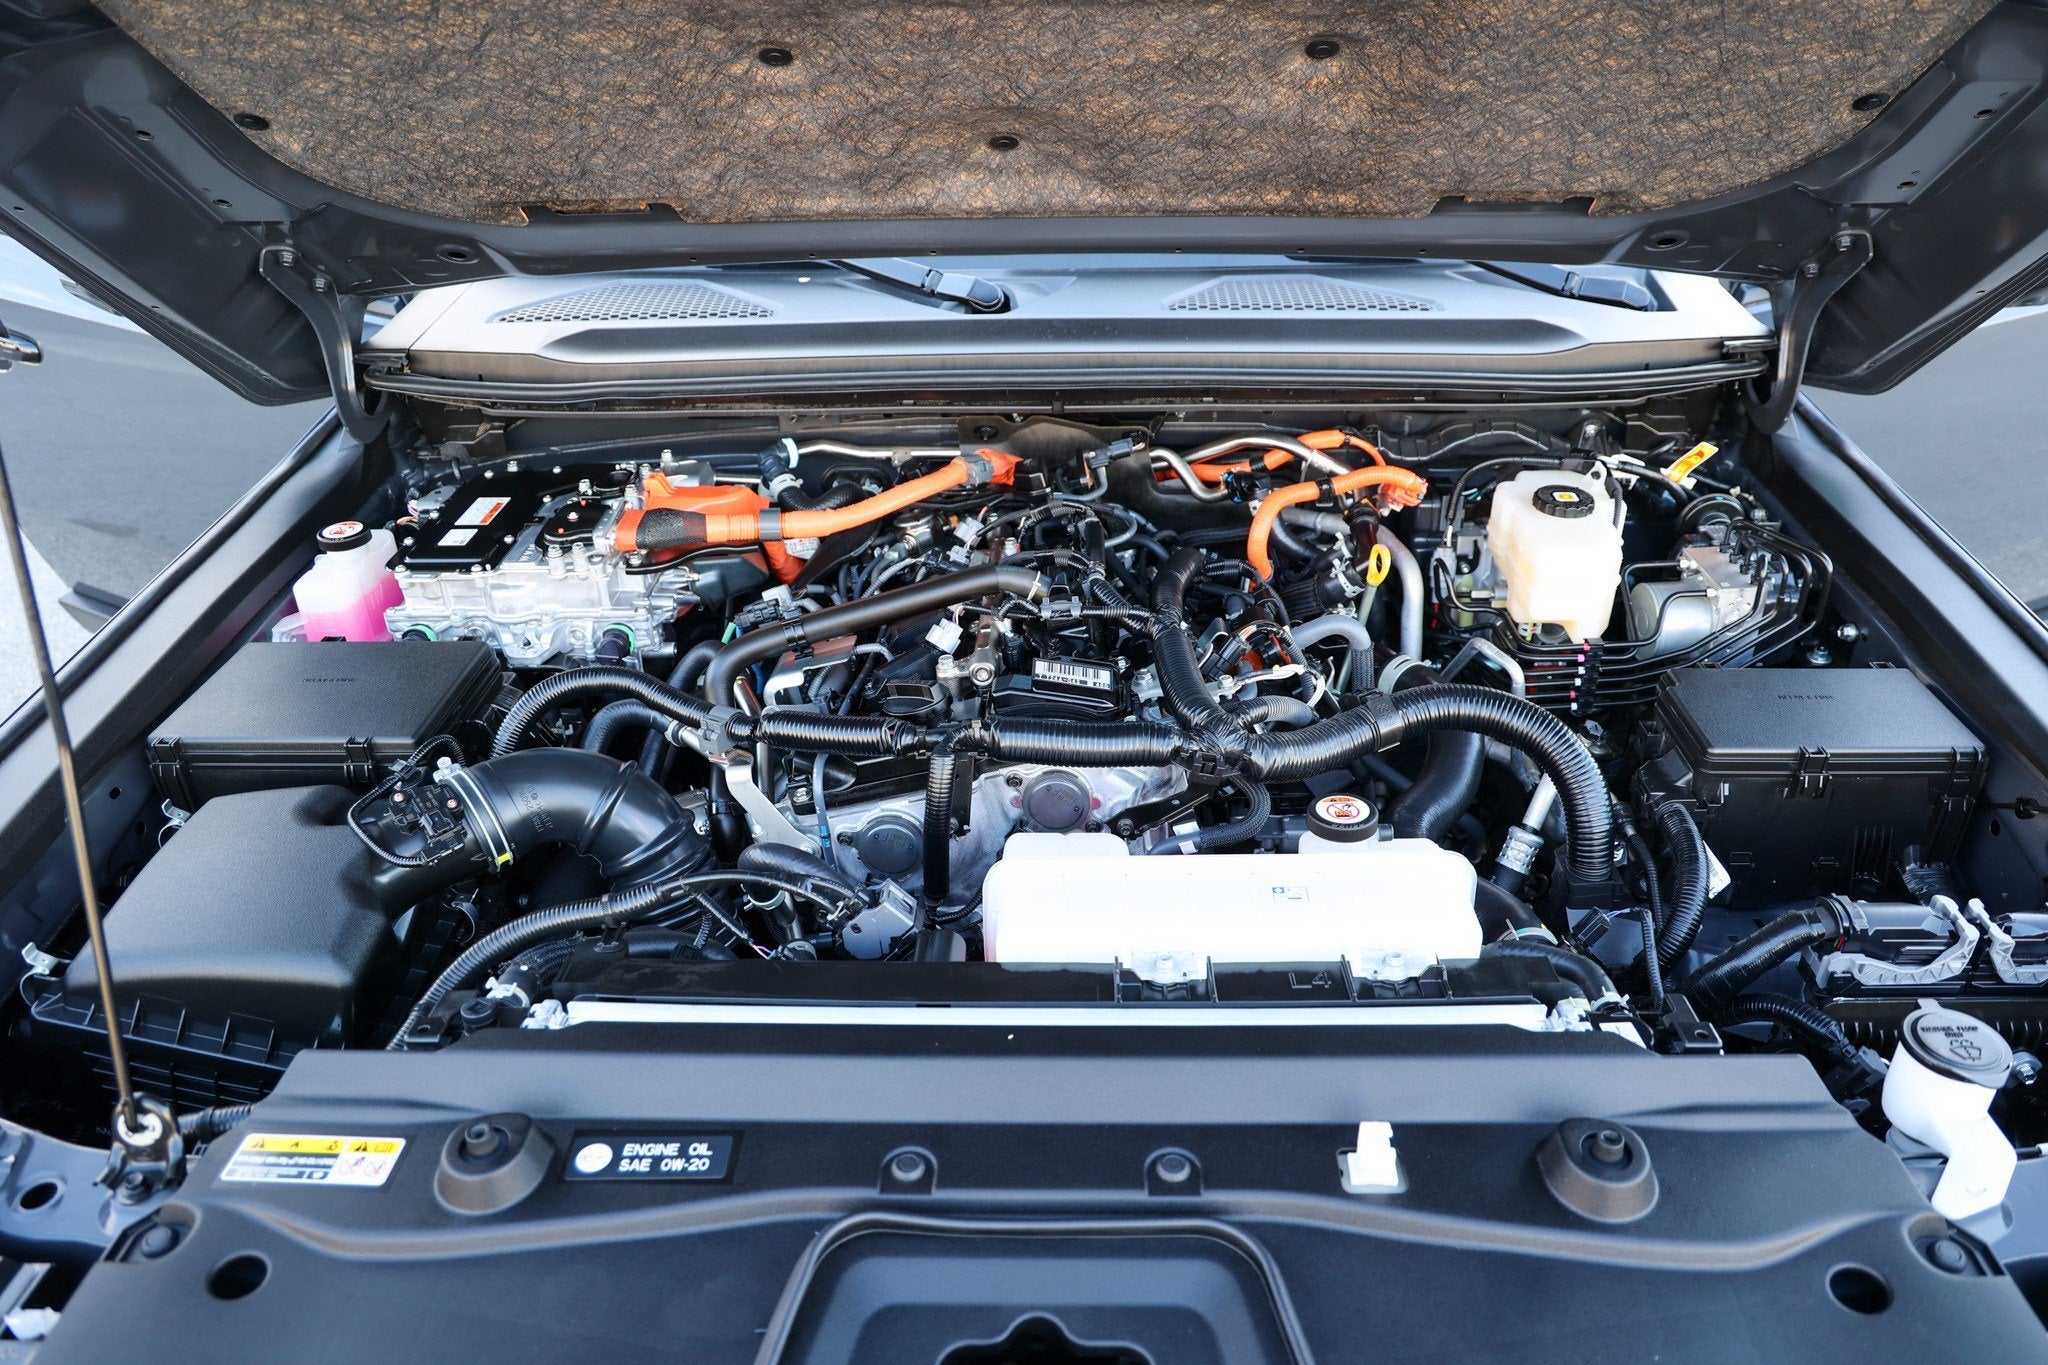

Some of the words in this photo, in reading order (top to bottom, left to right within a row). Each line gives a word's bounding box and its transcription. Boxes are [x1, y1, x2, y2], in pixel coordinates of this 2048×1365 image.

[1288, 970, 1332, 989] L4
[622, 1143, 681, 1156] ENGINE
[688, 1143, 713, 1156] OIL
[618, 1158, 653, 1172] SAE
[660, 1157, 711, 1172] 0W-20
